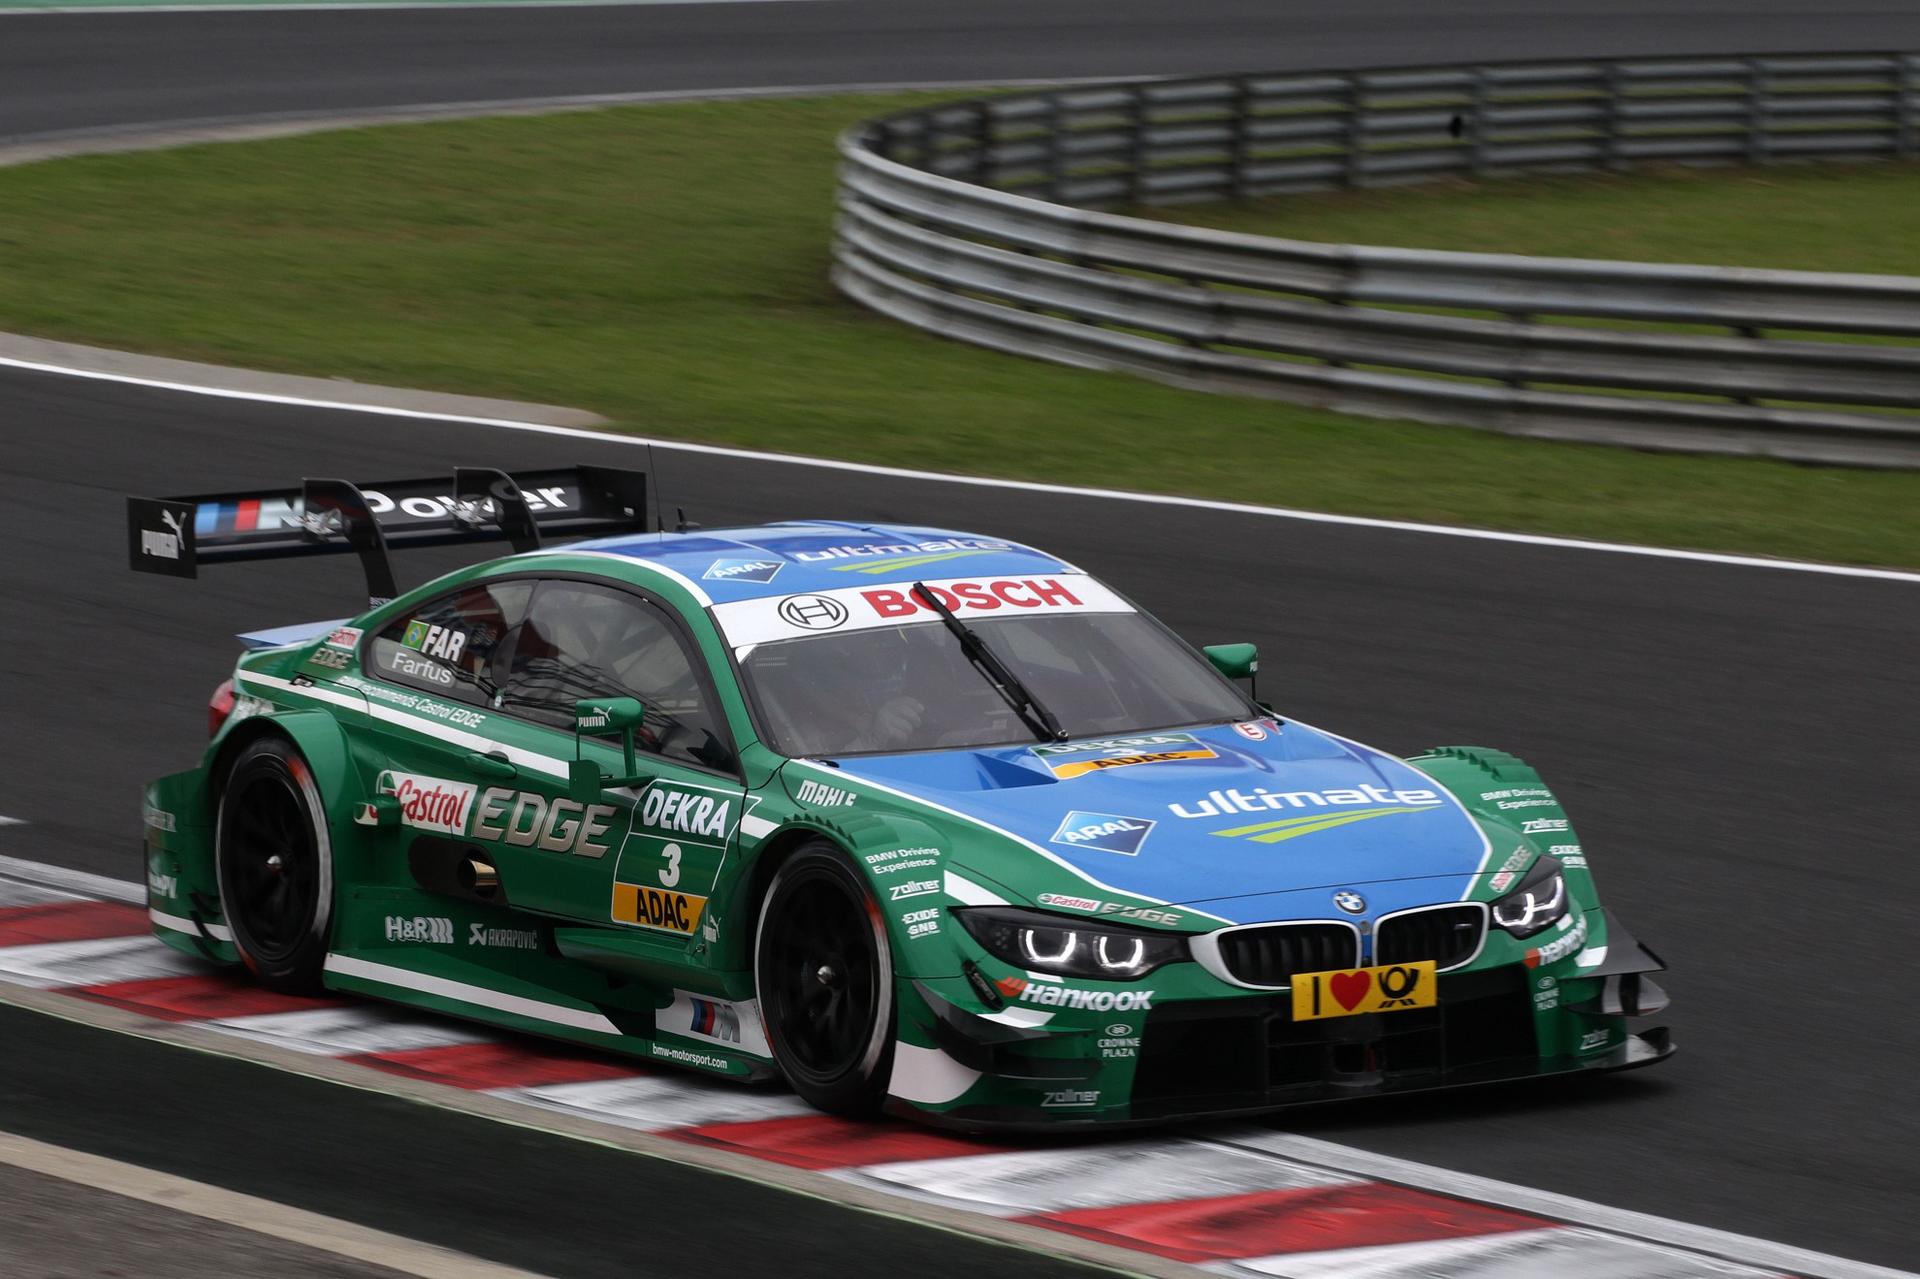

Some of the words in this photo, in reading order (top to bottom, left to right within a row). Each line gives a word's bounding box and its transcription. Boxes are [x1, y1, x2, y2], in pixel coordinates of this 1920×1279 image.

[794, 538, 1012, 562] ultimate
[712, 562, 776, 579] ARAL
[860, 579, 1083, 618] BOSCH
[421, 625, 466, 662] FAR
[392, 652, 452, 684] Farfus
[415, 698, 450, 719] Castrol
[449, 708, 487, 729] EDGE
[1090, 751, 1188, 769] ADAC
[641, 788, 730, 839] DEKRA
[1167, 783, 1443, 819] ultimate
[397, 778, 470, 829] Castrol
[471, 786, 618, 859] EDGE
[1064, 819, 1146, 843] ARAL
[658, 843, 682, 888] 3
[864, 850, 898, 865] BMW
[899, 847, 941, 858] Driving
[872, 857, 938, 875] Experience
[888, 879, 941, 901] zollner
[635, 888, 690, 932] ADAC
[904, 907, 940, 925] EXIDE
[1051, 896, 1097, 910] Castrol
[1100, 902, 1184, 926] EDGE
[385, 915, 430, 941] H&R
[908, 921, 939, 936] GNB
[1312, 975, 1320, 1016] I
[652, 1043, 728, 1069] bmw-motorsport.com
[1097, 1038, 1141, 1048] CROWNE
[1102, 1048, 1136, 1057] PLAZA
[1040, 1089, 1101, 1107] zollner
